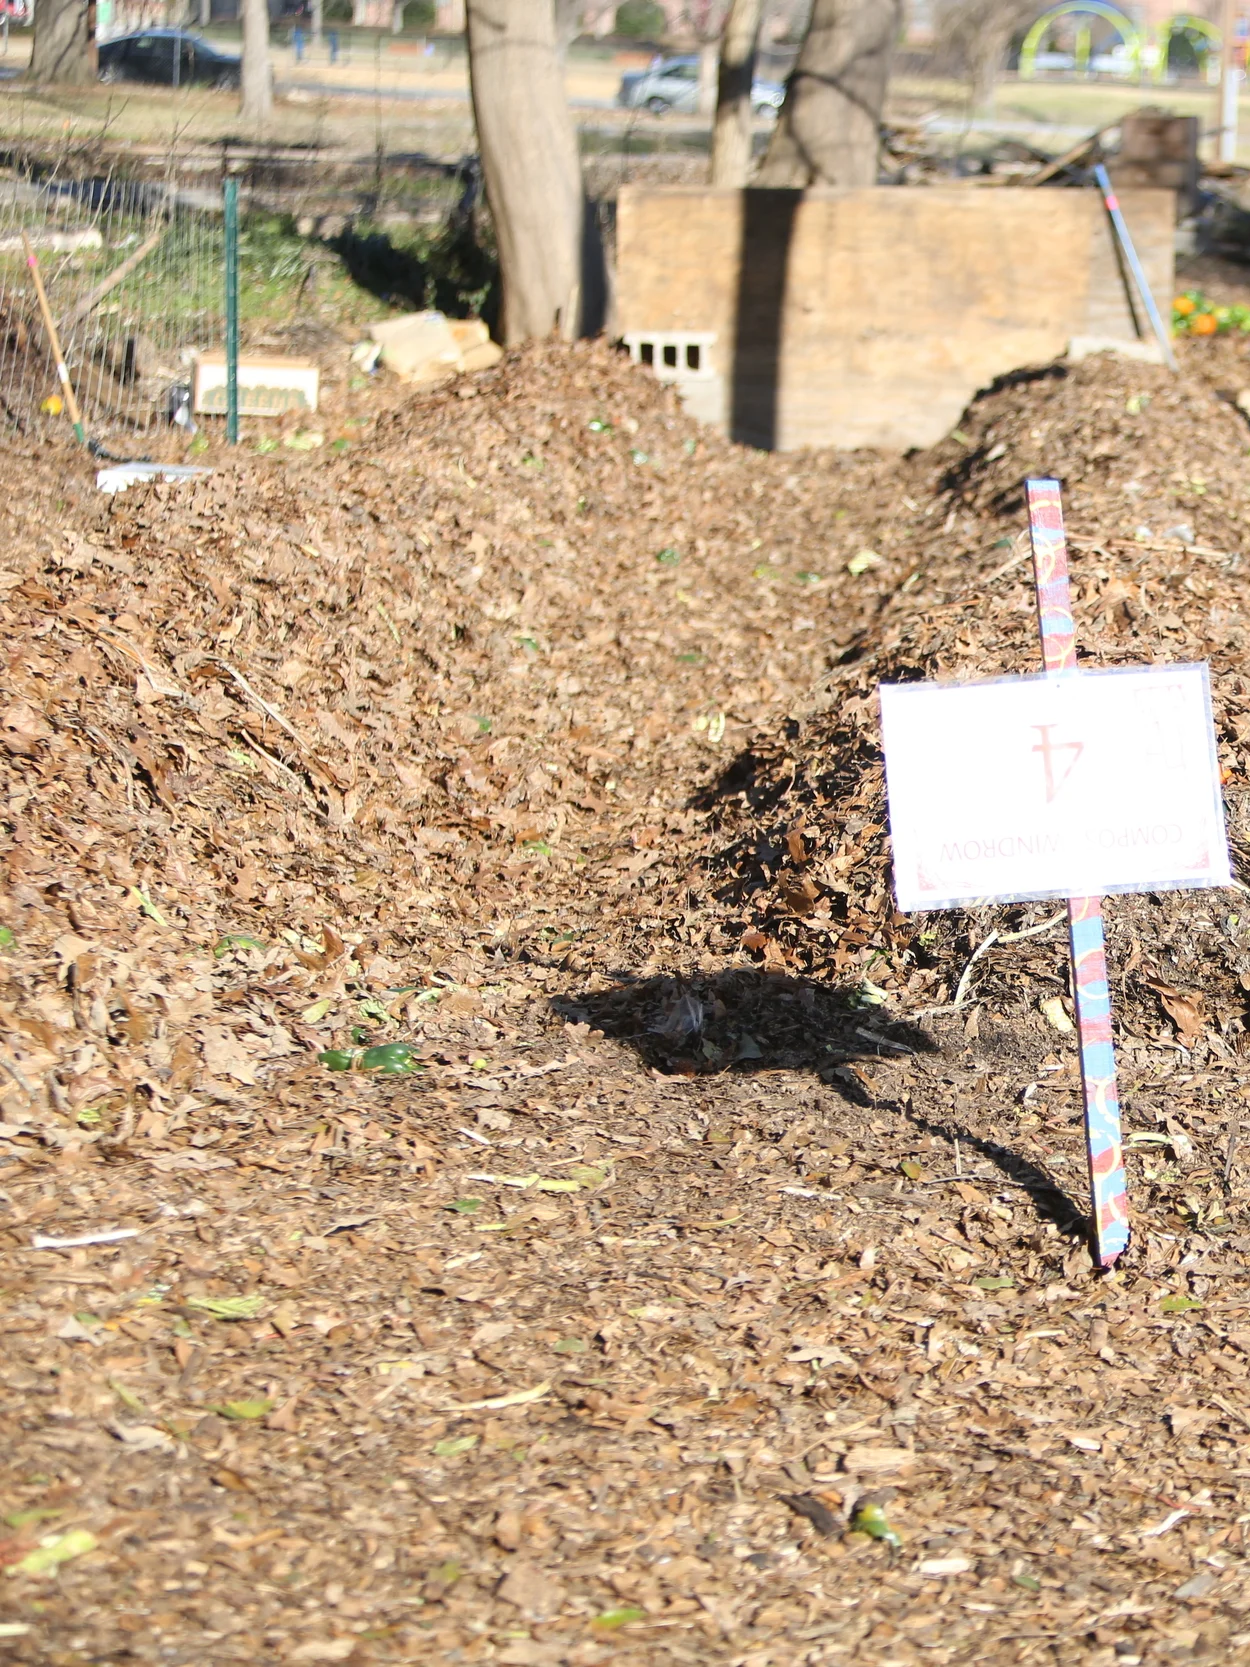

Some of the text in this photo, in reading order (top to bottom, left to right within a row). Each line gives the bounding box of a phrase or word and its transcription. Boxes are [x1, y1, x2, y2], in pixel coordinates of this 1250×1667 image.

[1030, 724, 1084, 804] 4
[940, 823, 1182, 862] COMPOS WINDROW
